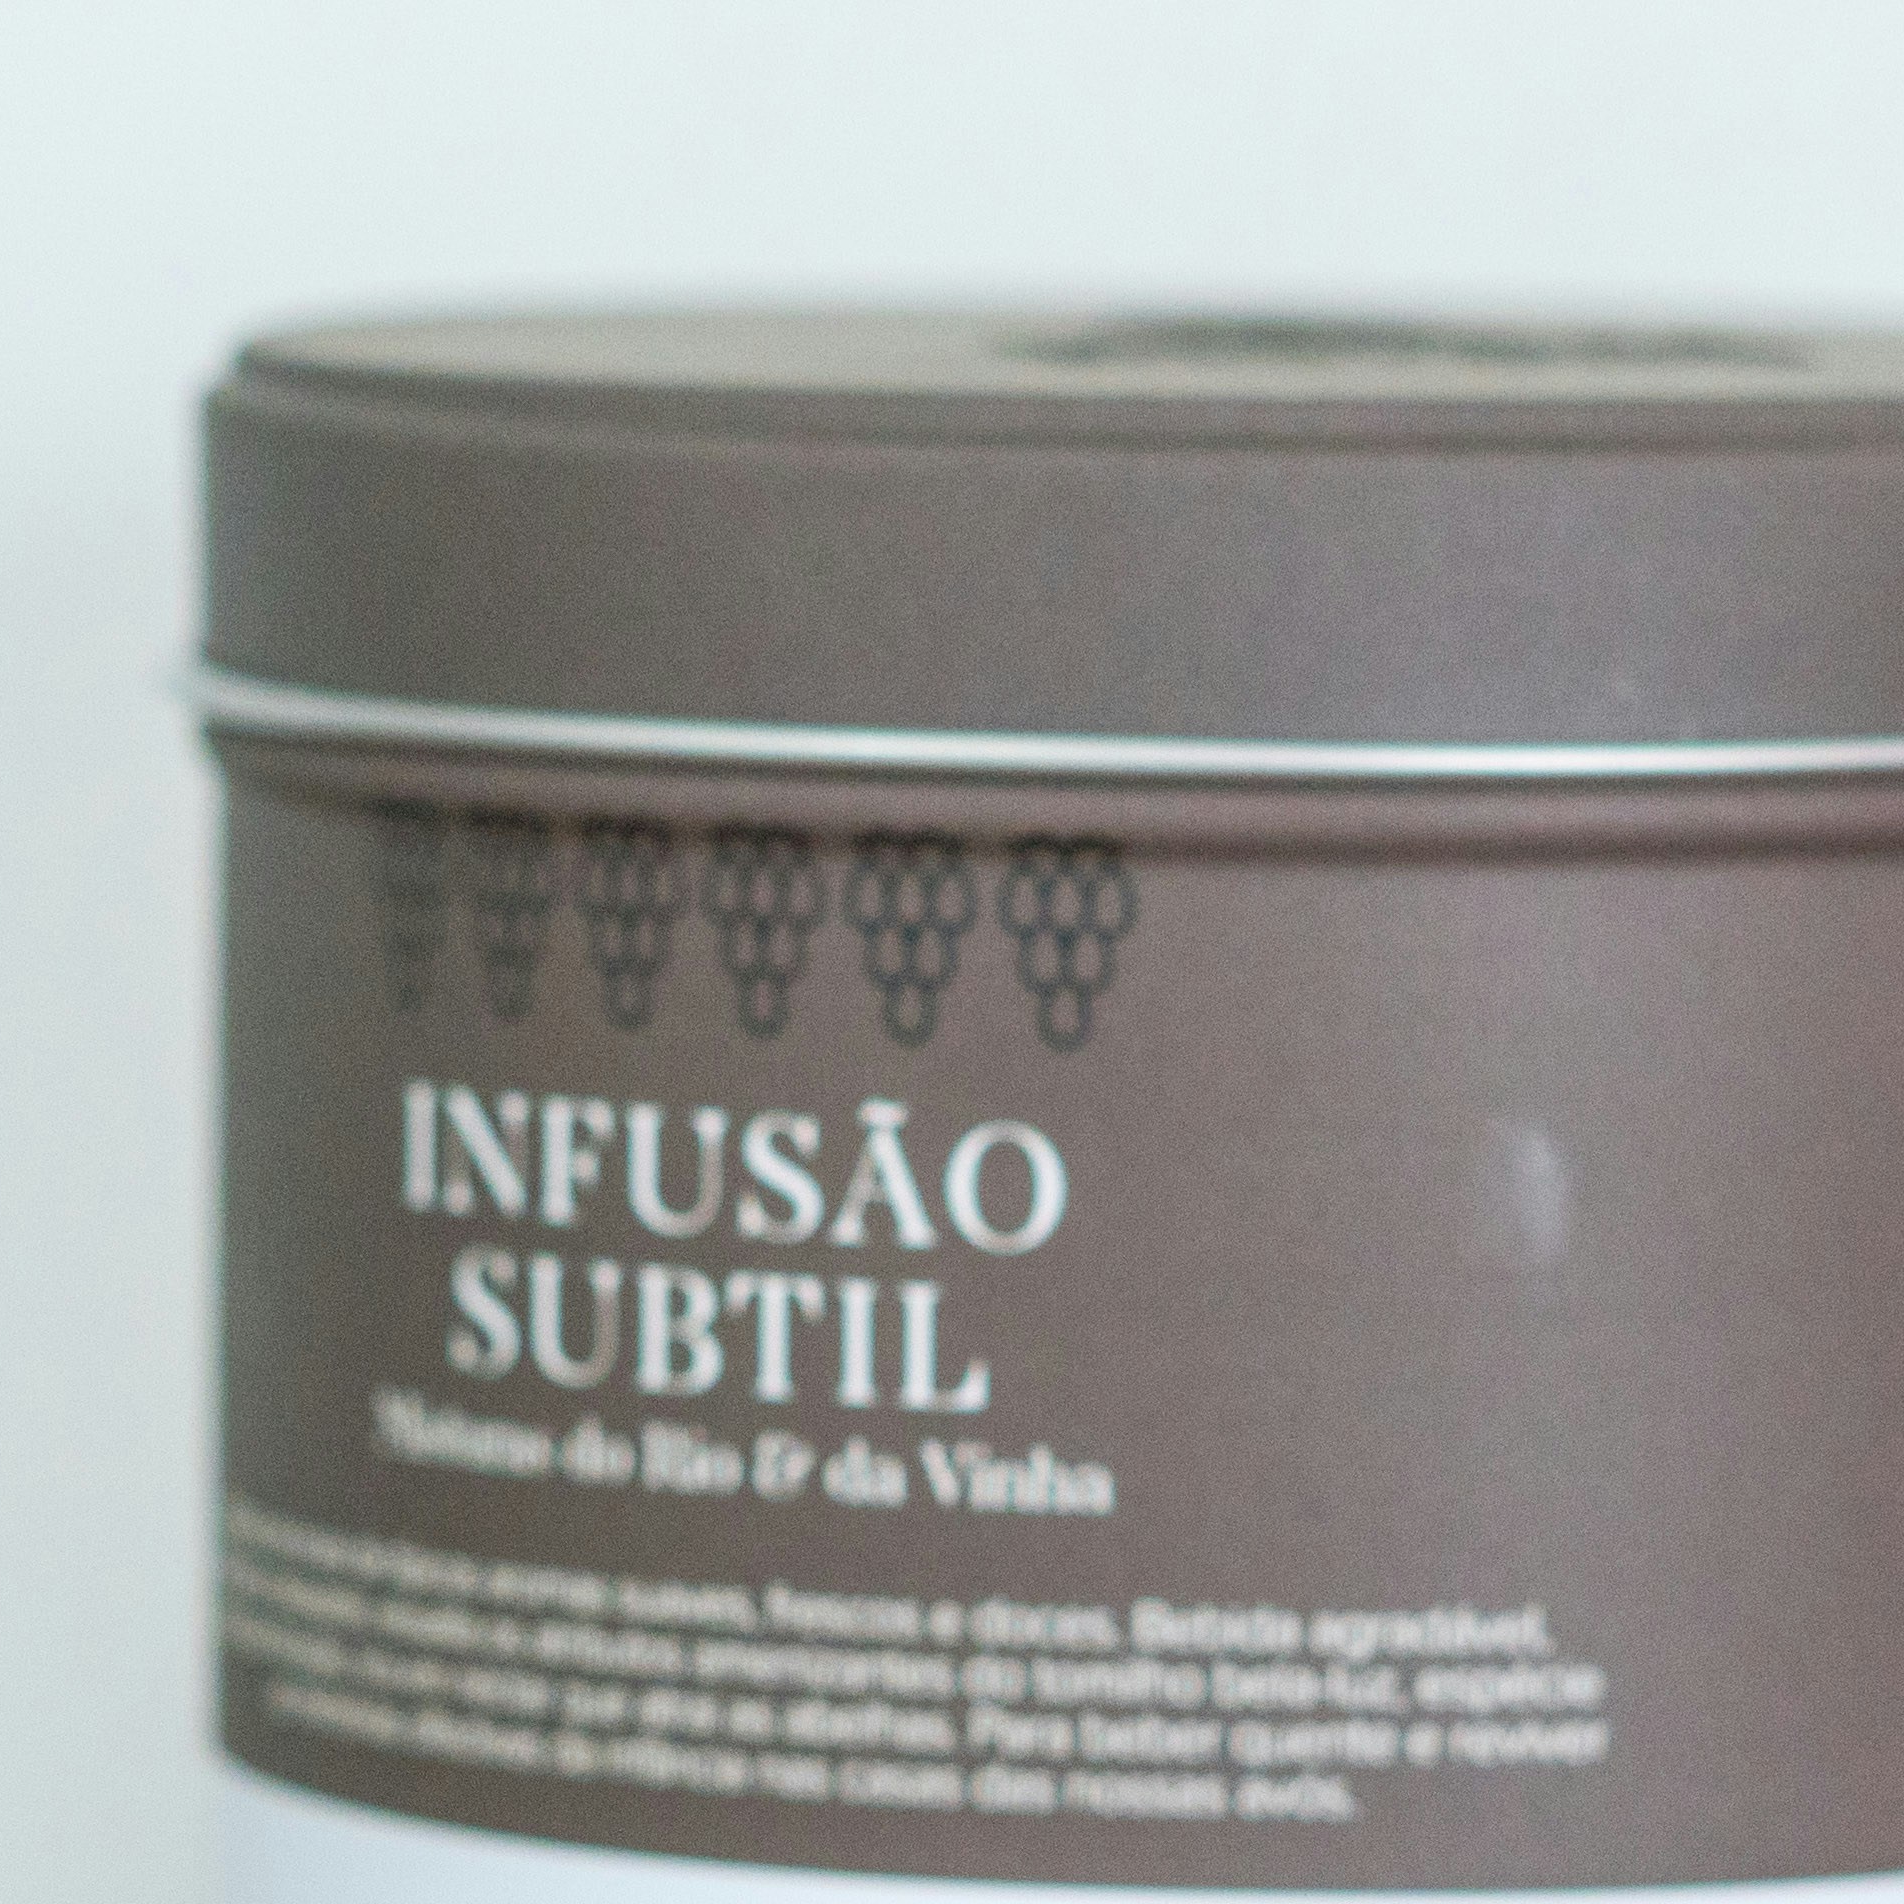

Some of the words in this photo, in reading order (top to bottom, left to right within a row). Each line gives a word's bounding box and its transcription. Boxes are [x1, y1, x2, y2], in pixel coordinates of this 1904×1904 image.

[401, 1078, 1069, 1256] INFUSÃO
[445, 1242, 993, 1412] SUBTIL
[557, 1416, 635, 1486] do
[638, 1421, 746, 1496] Rio
[751, 1431, 817, 1502] &
[820, 1438, 909, 1508] da
[919, 1440, 1119, 1518] Vinha
[1130, 1597, 1301, 1652] Bebida
[965, 1704, 1074, 1758] Para
[1078, 1708, 1222, 1760] beber
[1227, 1714, 1399, 1768] quente
